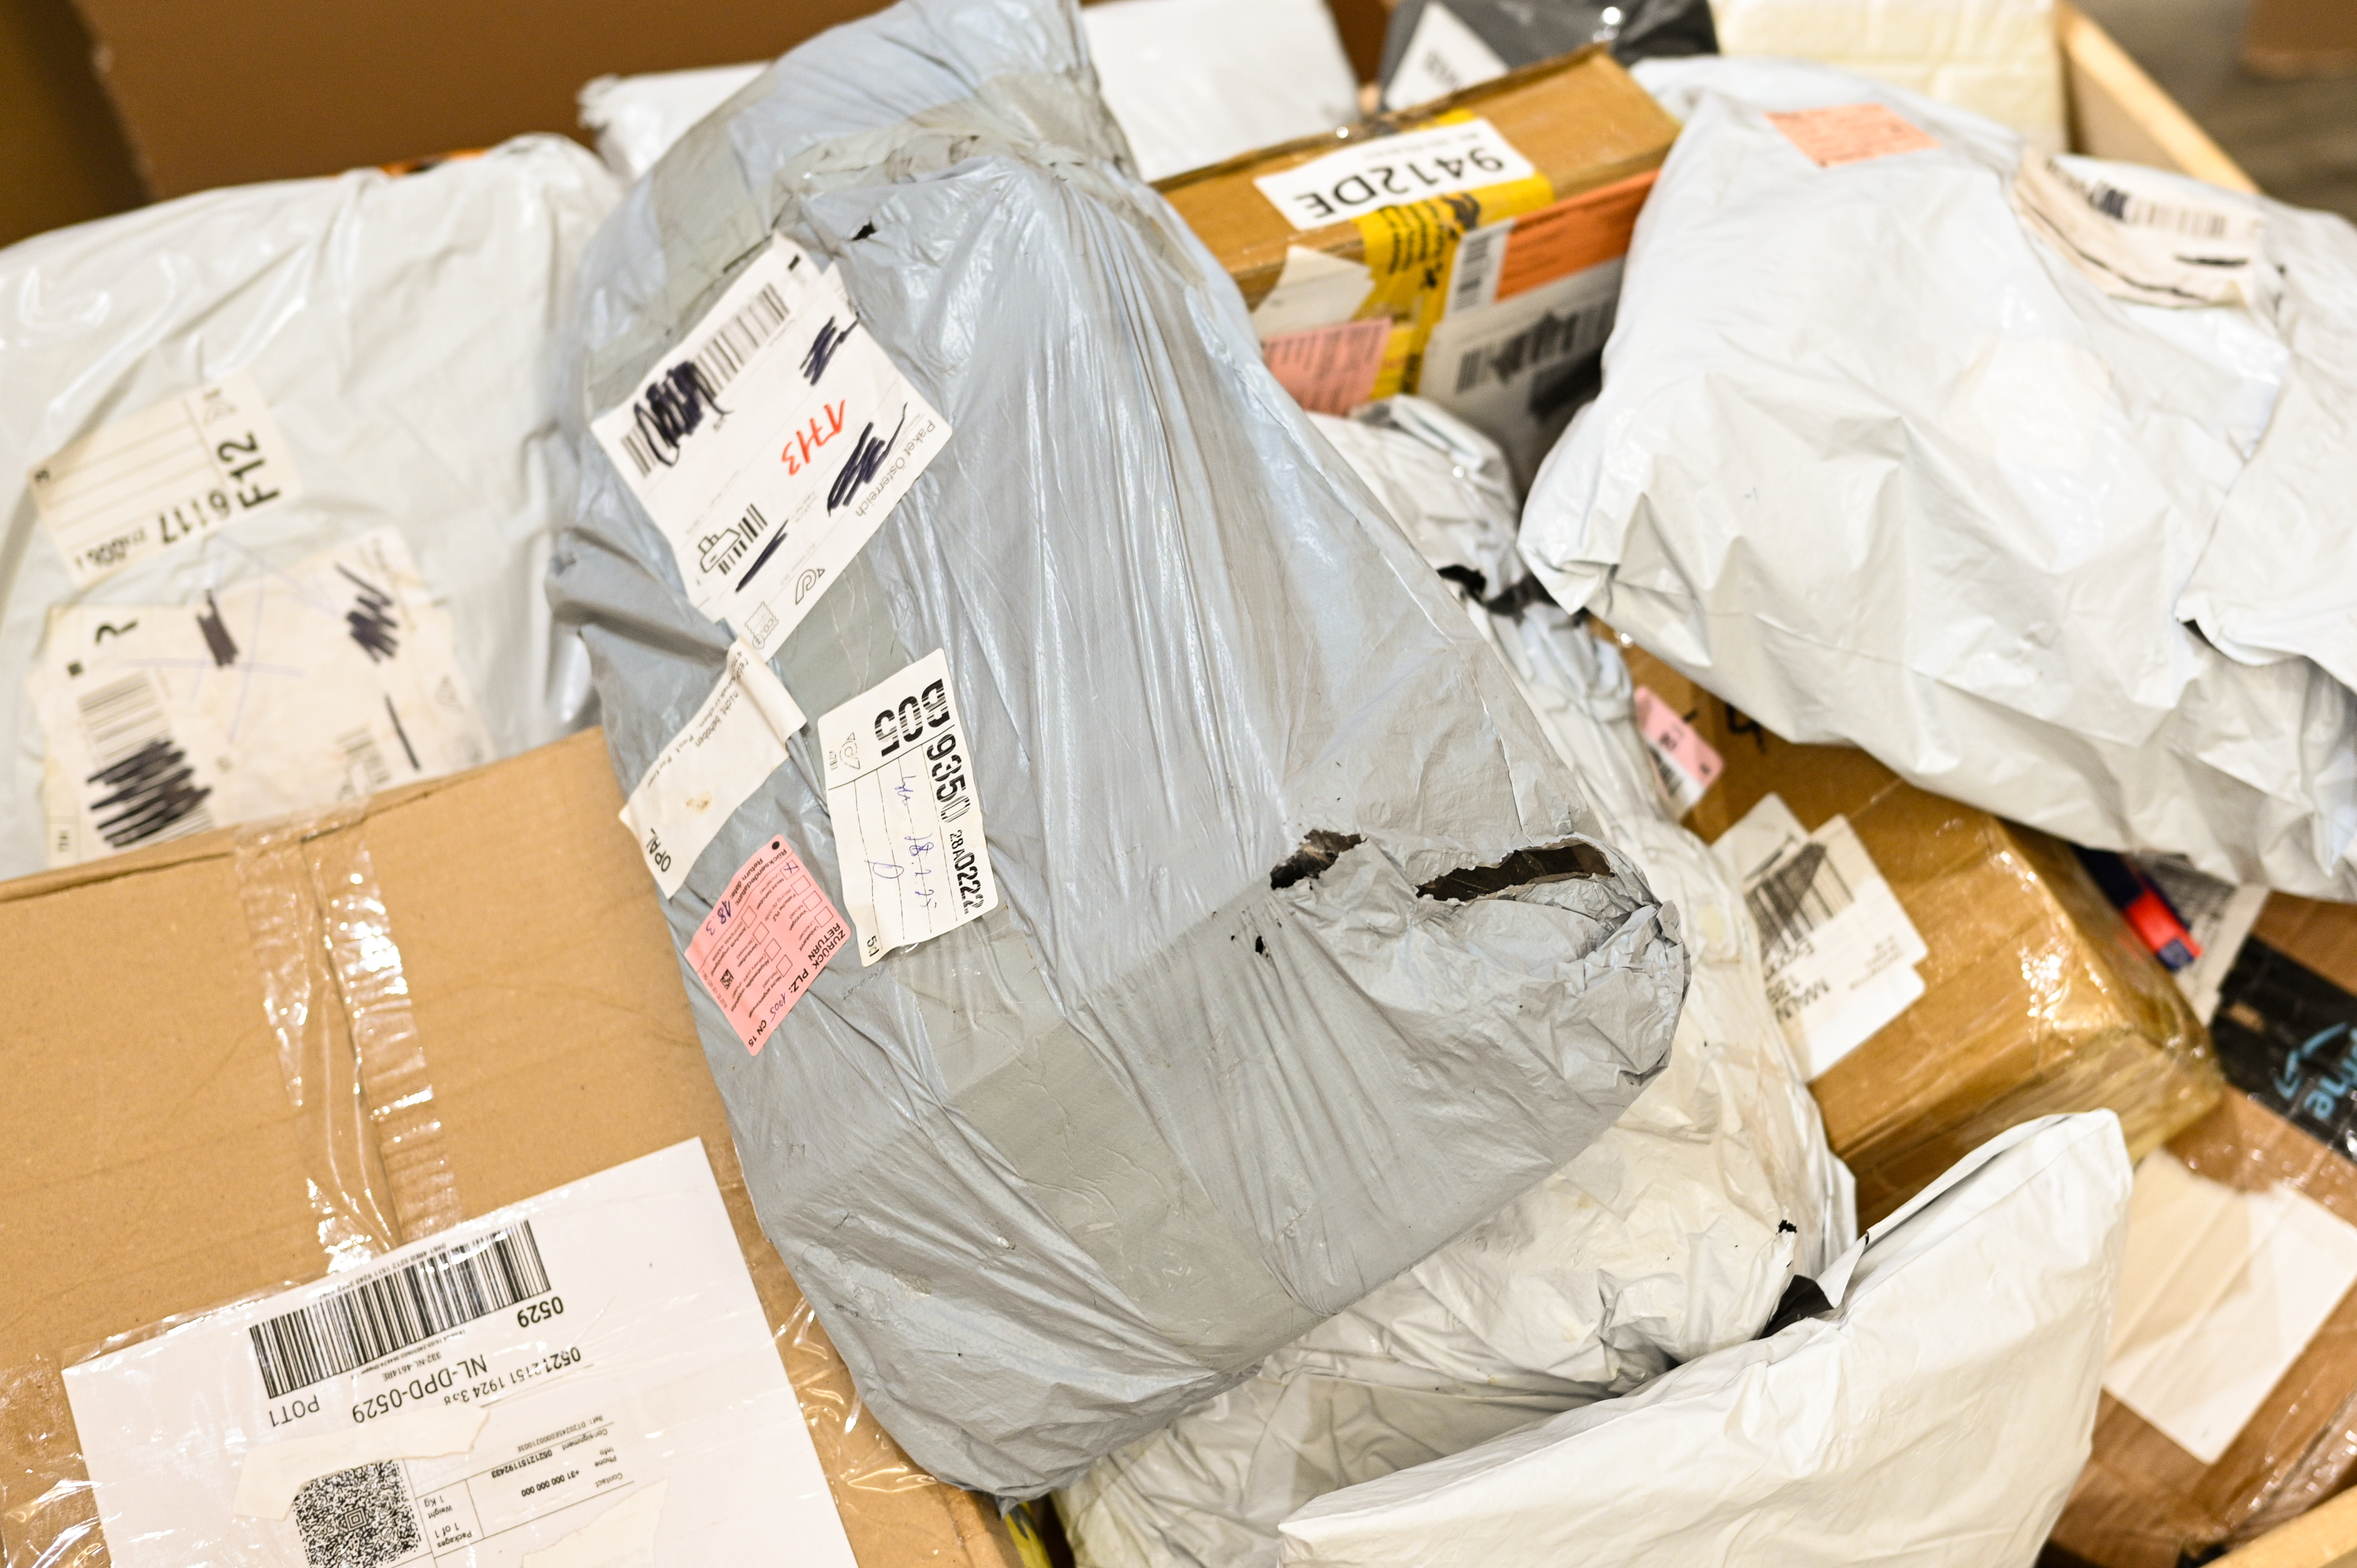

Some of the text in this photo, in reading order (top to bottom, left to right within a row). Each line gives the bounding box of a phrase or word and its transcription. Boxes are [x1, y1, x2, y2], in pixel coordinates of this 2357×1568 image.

[1296, 149, 1504, 217] 9412DE
[902, 419, 936, 457] Paket
[214, 431, 281, 511] F12
[854, 455, 907, 519] Österreich
[694, 691, 740, 748] nicht behoben
[645, 827, 673, 873] OPAL
[729, 857, 764, 899] Return date:
[735, 849, 787, 906] Rücksendedatum:
[755, 877, 784, 910] Nicht behoben
[771, 893, 796, 922] Falsche PLZ
[788, 909, 807, 931] Verzogen
[798, 925, 819, 951] Unbekannt
[808, 923, 840, 961] RETURN
[737, 943, 758, 968] Verstorben
[788, 930, 845, 994] ZURÜCK PLZ:
[770, 975, 782, 989] Nicht
[748, 1019, 768, 1047] CN 15
[516, 1295, 565, 1329] 0529
[509, 1361, 542, 1385] 2151
[542, 1346, 582, 1374] 0521
[352, 1355, 487, 1423] NL-DPD-0529
[471, 1375, 506, 1399] 1924
[267, 1394, 321, 1428] POT1
[561, 1428, 608, 1451] Consignment
[599, 1446, 614, 1456] Info
[520, 1455, 617, 1497] Phone +31 000 000 000
[595, 1471, 623, 1488] Contact
[423, 1495, 444, 1508] 1 Kg
[427, 1504, 453, 1519] Weight
[434, 1522, 460, 1539] 1 of 1
[436, 1530, 472, 1548] Packages
